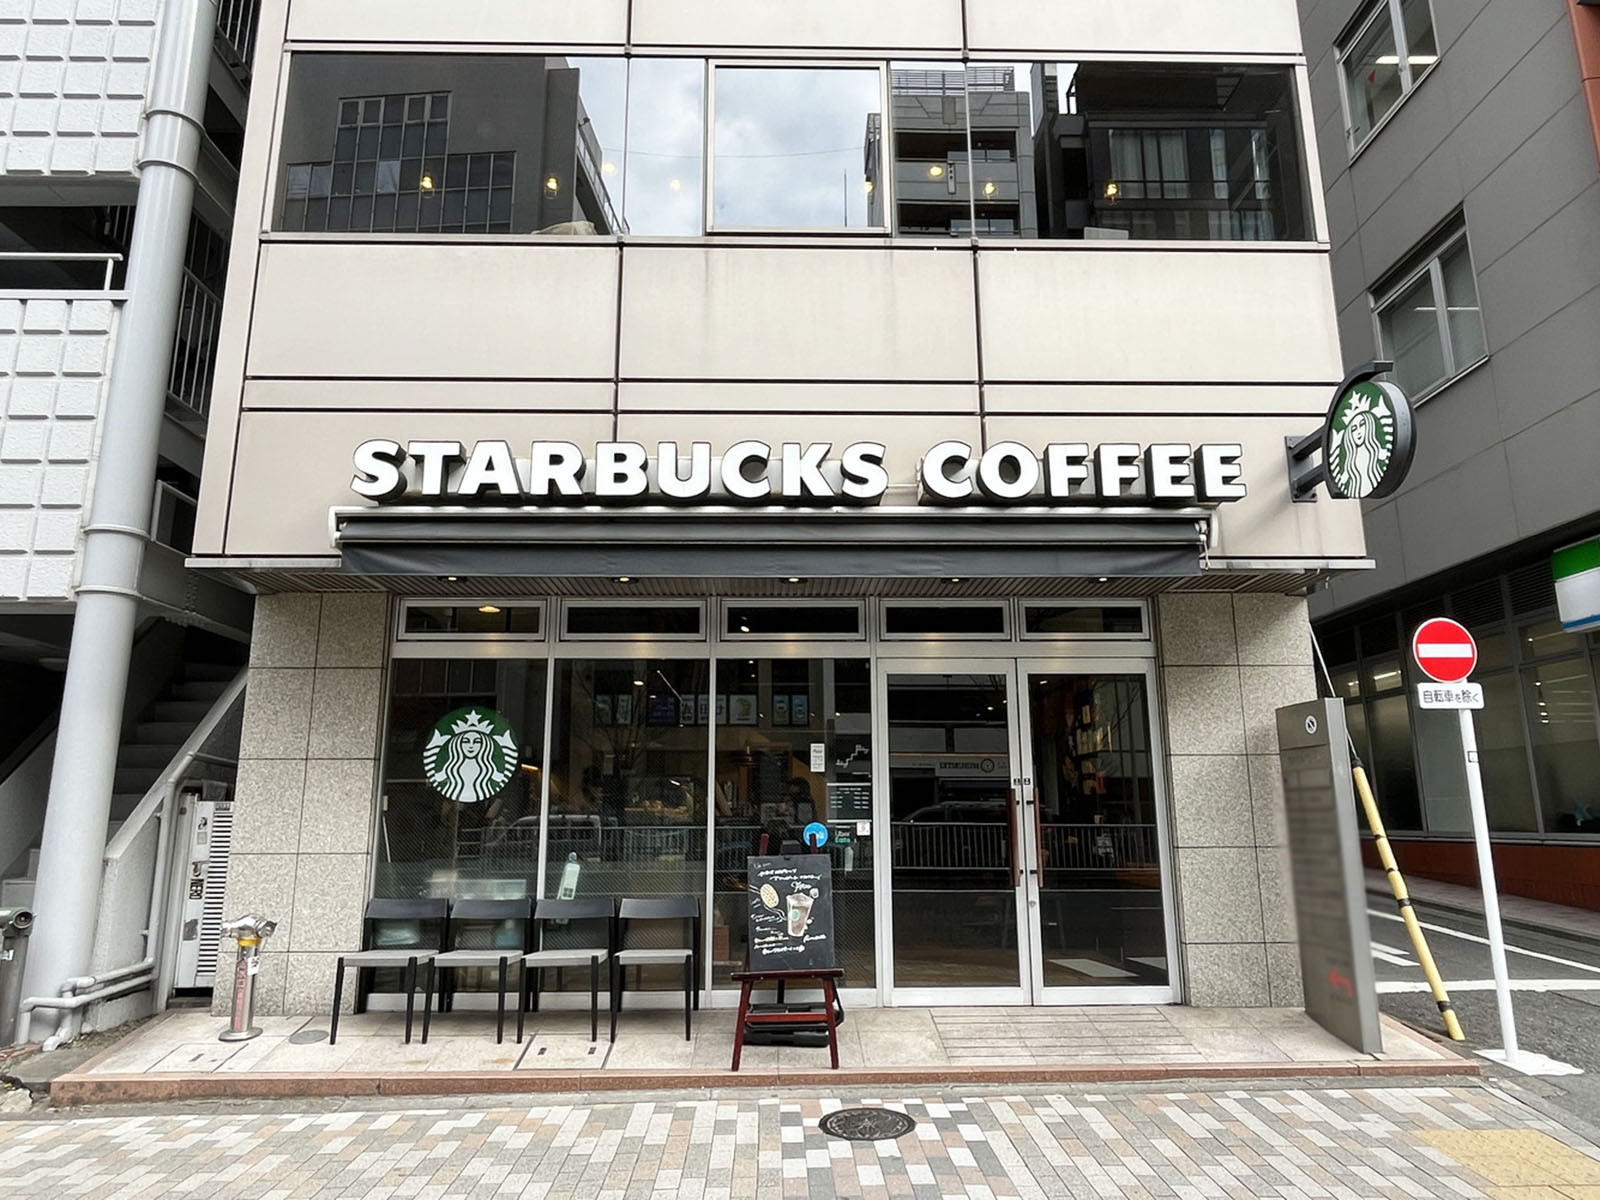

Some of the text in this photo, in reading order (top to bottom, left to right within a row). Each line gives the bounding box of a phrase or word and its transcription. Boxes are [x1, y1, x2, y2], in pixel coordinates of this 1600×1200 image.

[350, 439, 1247, 501] STARBUCKS COFFEE
[1423, 690, 1479, 704] 自転車を除く
